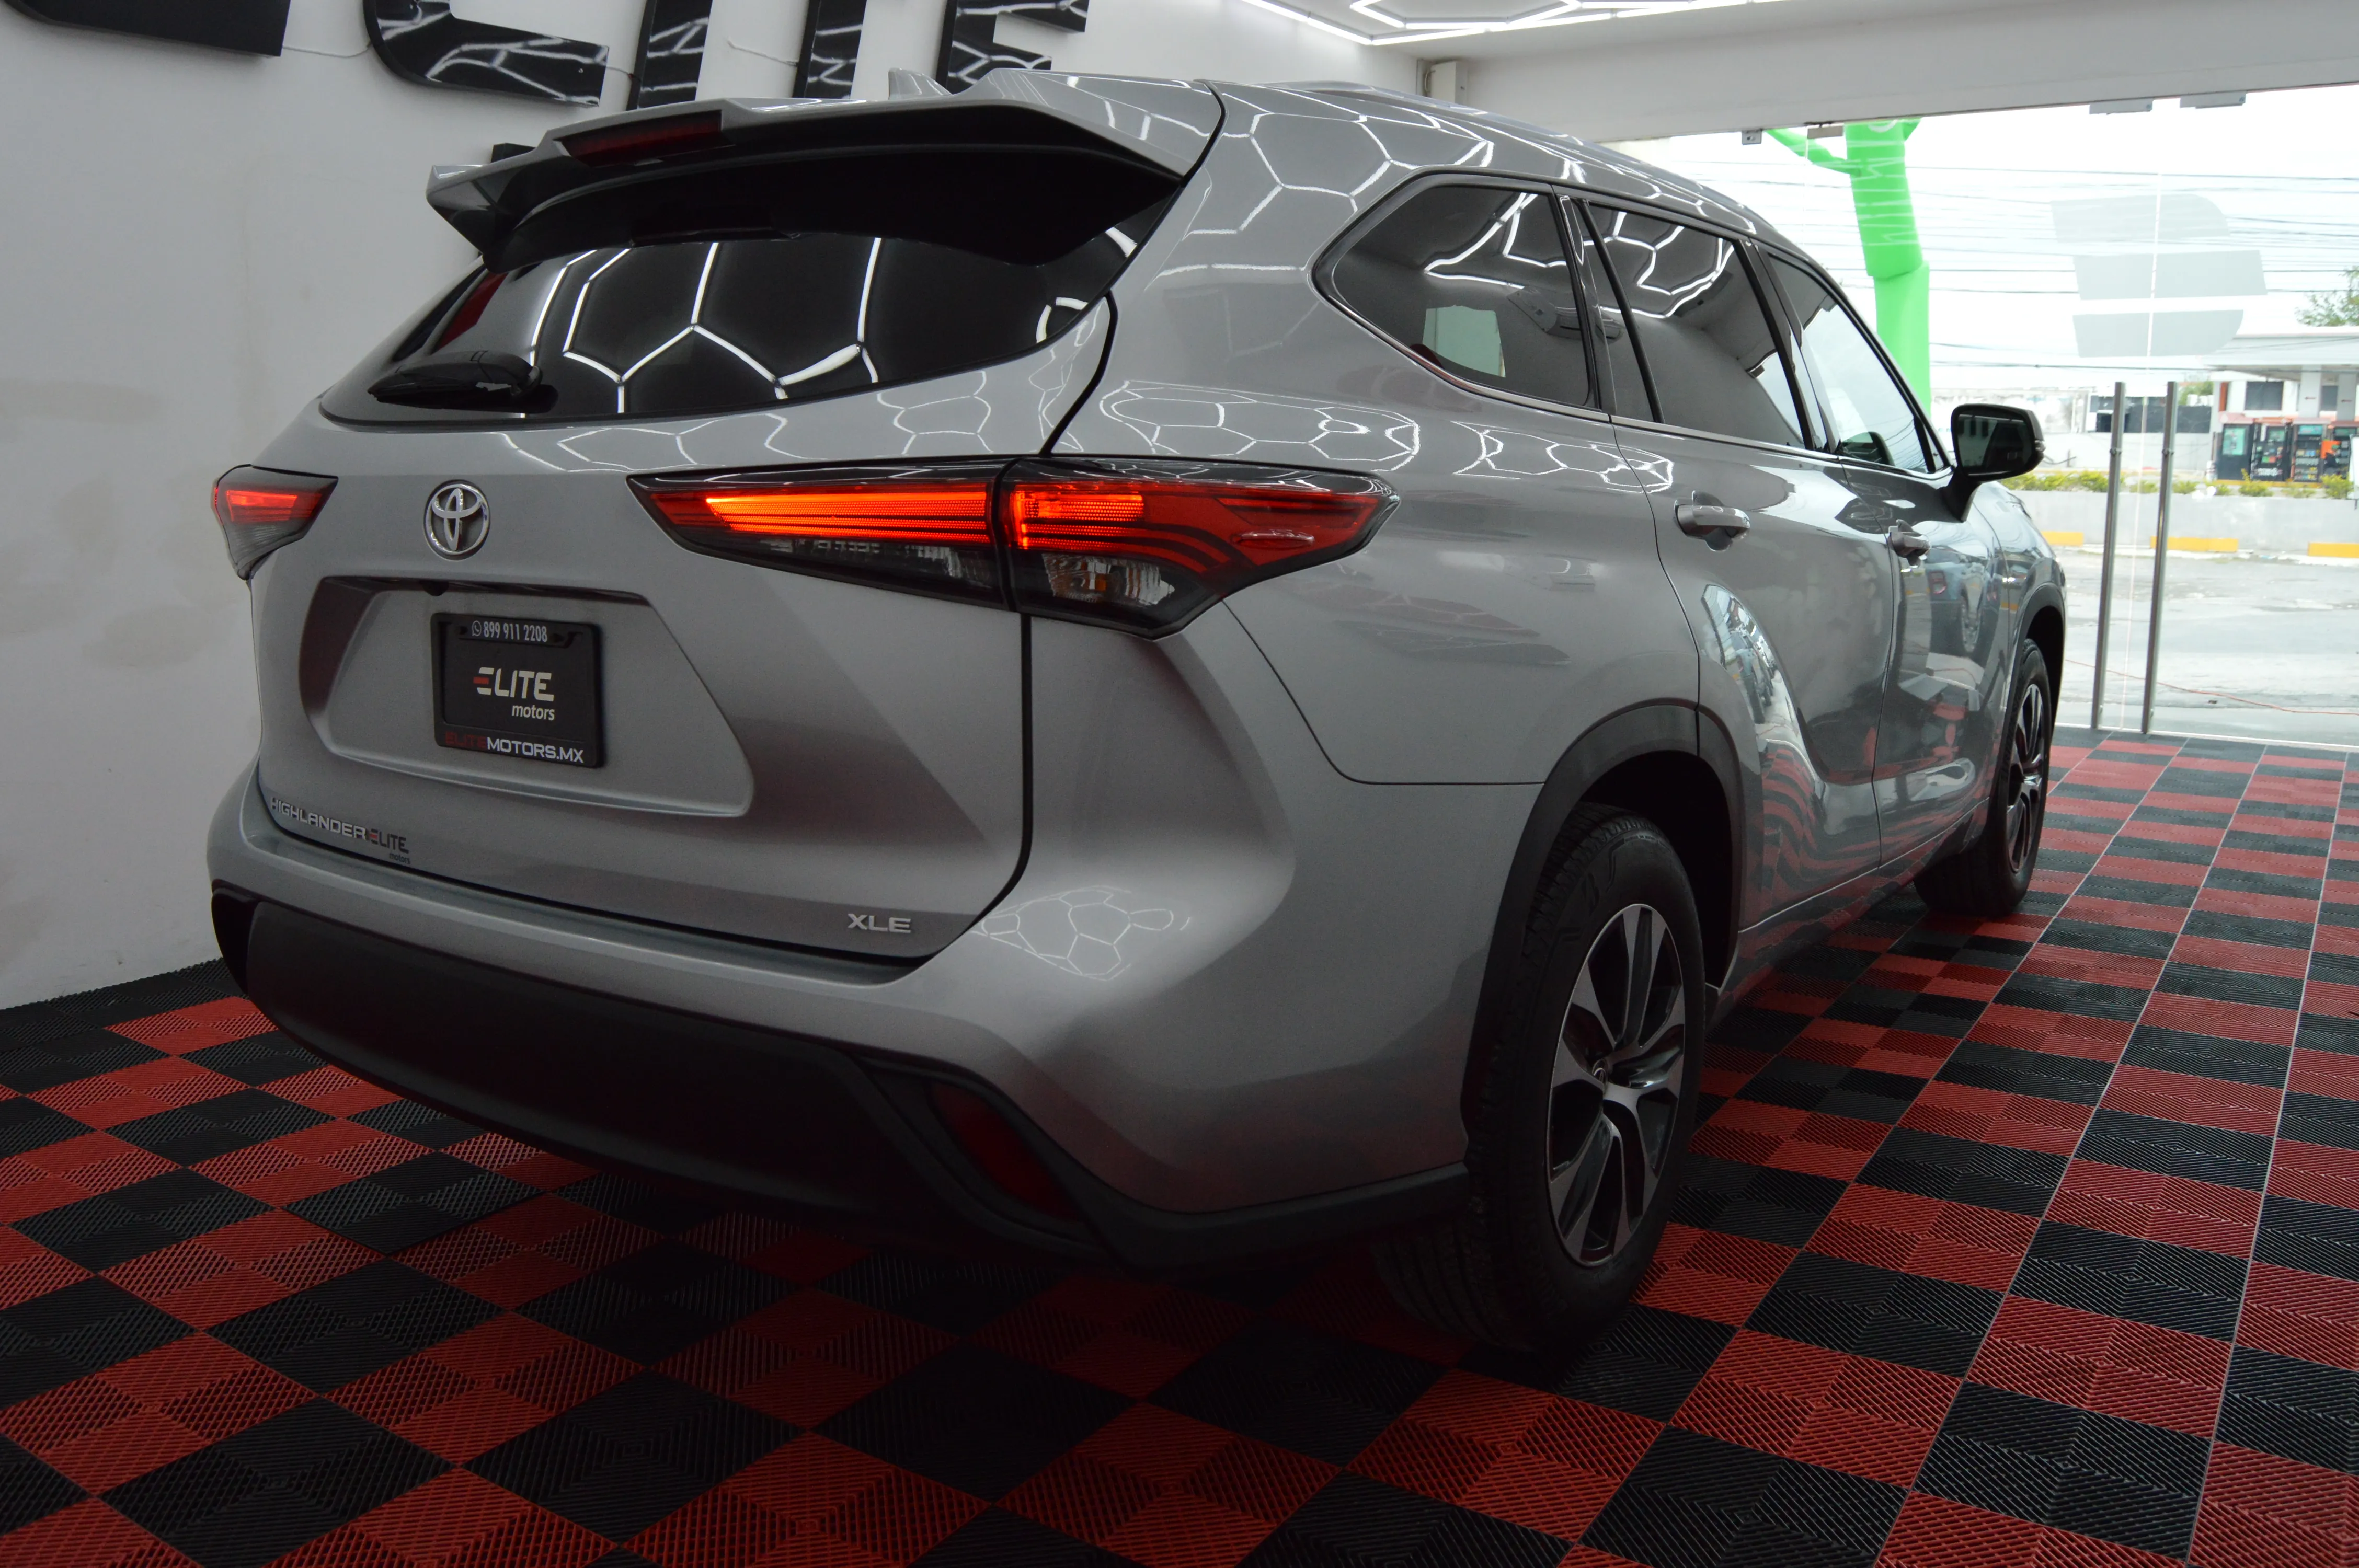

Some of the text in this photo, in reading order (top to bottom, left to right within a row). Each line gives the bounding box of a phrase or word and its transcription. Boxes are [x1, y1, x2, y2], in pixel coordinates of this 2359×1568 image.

[483, 621, 548, 642] 899 911 2208
[473, 667, 554, 701] ELITE
[511, 704, 555, 721] motors
[271, 798, 409, 854] HIGHLANDER ELITE
[388, 852, 410, 864] motors
[848, 913, 911, 933] XLE
